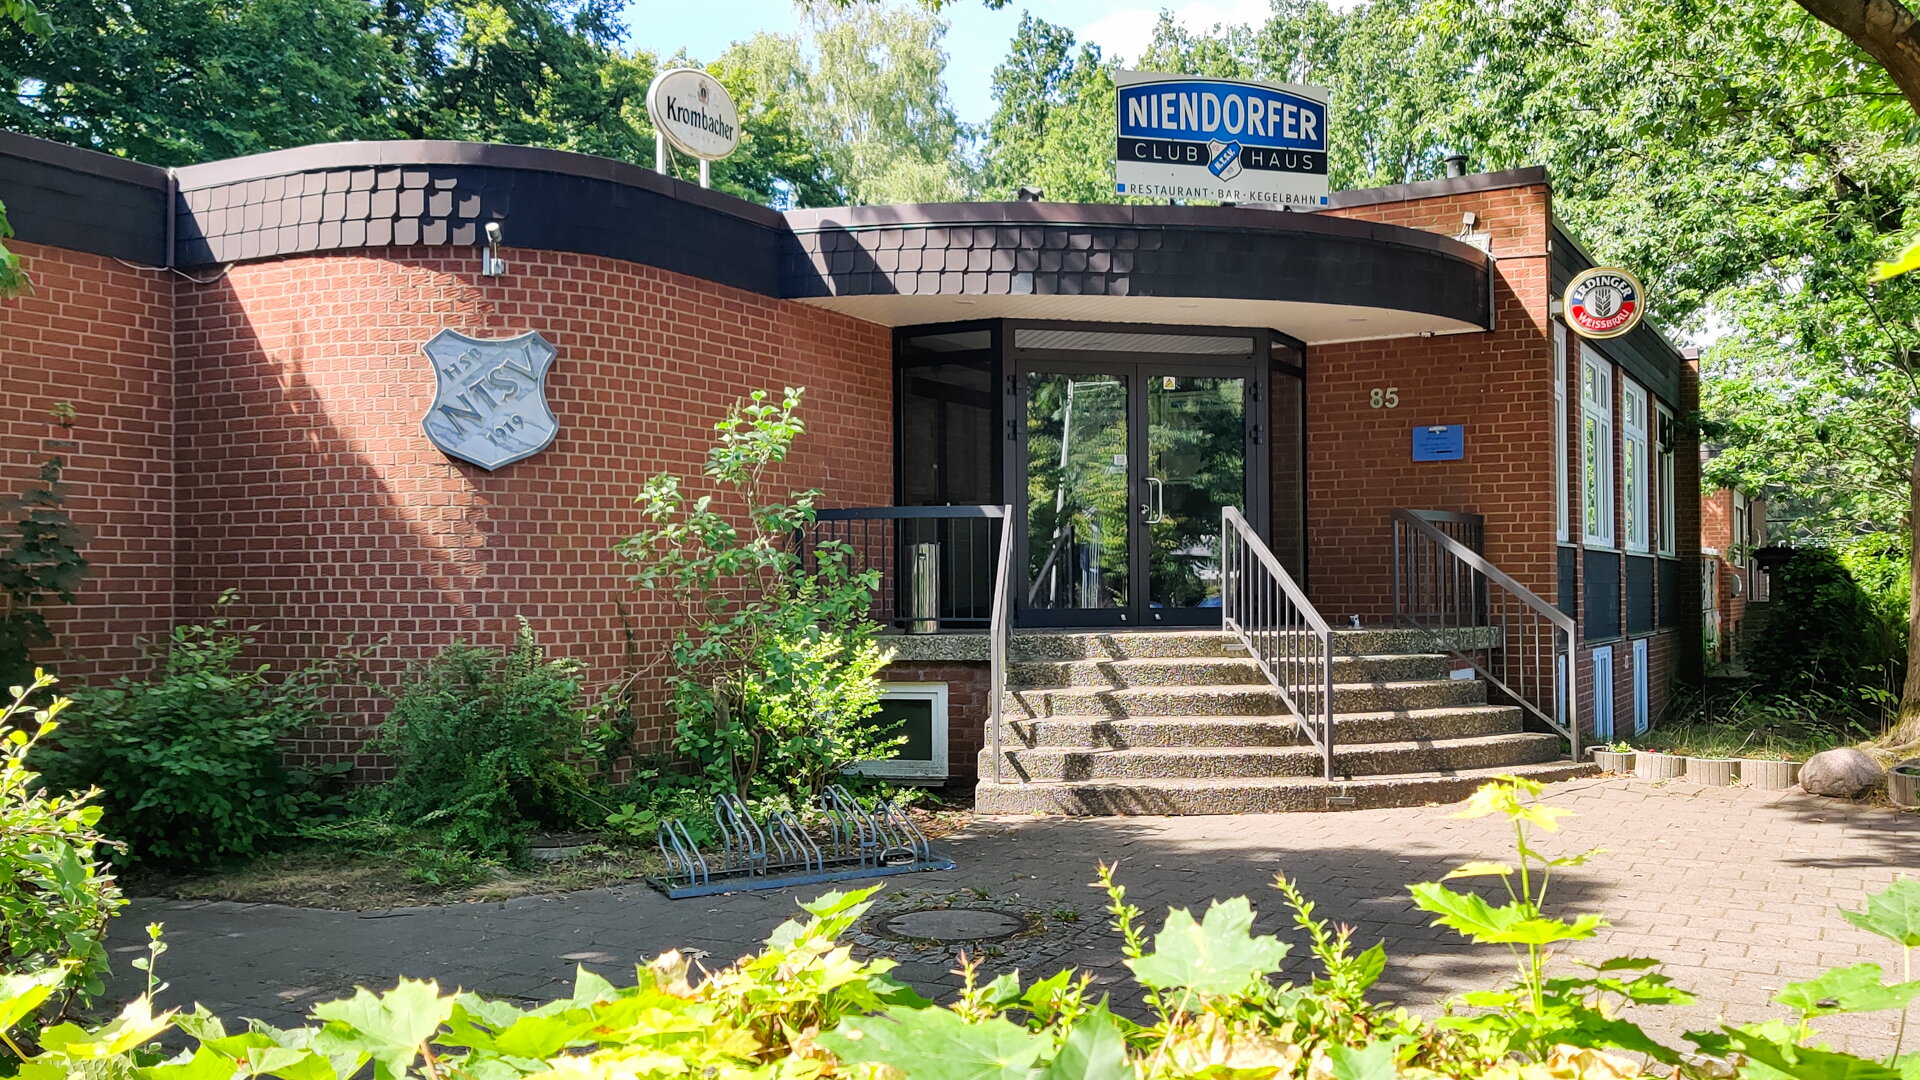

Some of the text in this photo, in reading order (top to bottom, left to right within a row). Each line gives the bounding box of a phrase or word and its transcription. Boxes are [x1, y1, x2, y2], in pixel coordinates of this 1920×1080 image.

[667, 95, 734, 141] Krombacher
[1128, 92, 1318, 141] NIENDORFER
[1134, 142, 1313, 170] CLUB HAUS
[1130, 184, 1317, 205] RESTAURANT BAR KEGELBAHN
[1574, 276, 1632, 301] ERDINGER
[437, 338, 539, 436] NTSV
[1370, 387, 1399, 409] 85
[485, 413, 525, 447] 1919
